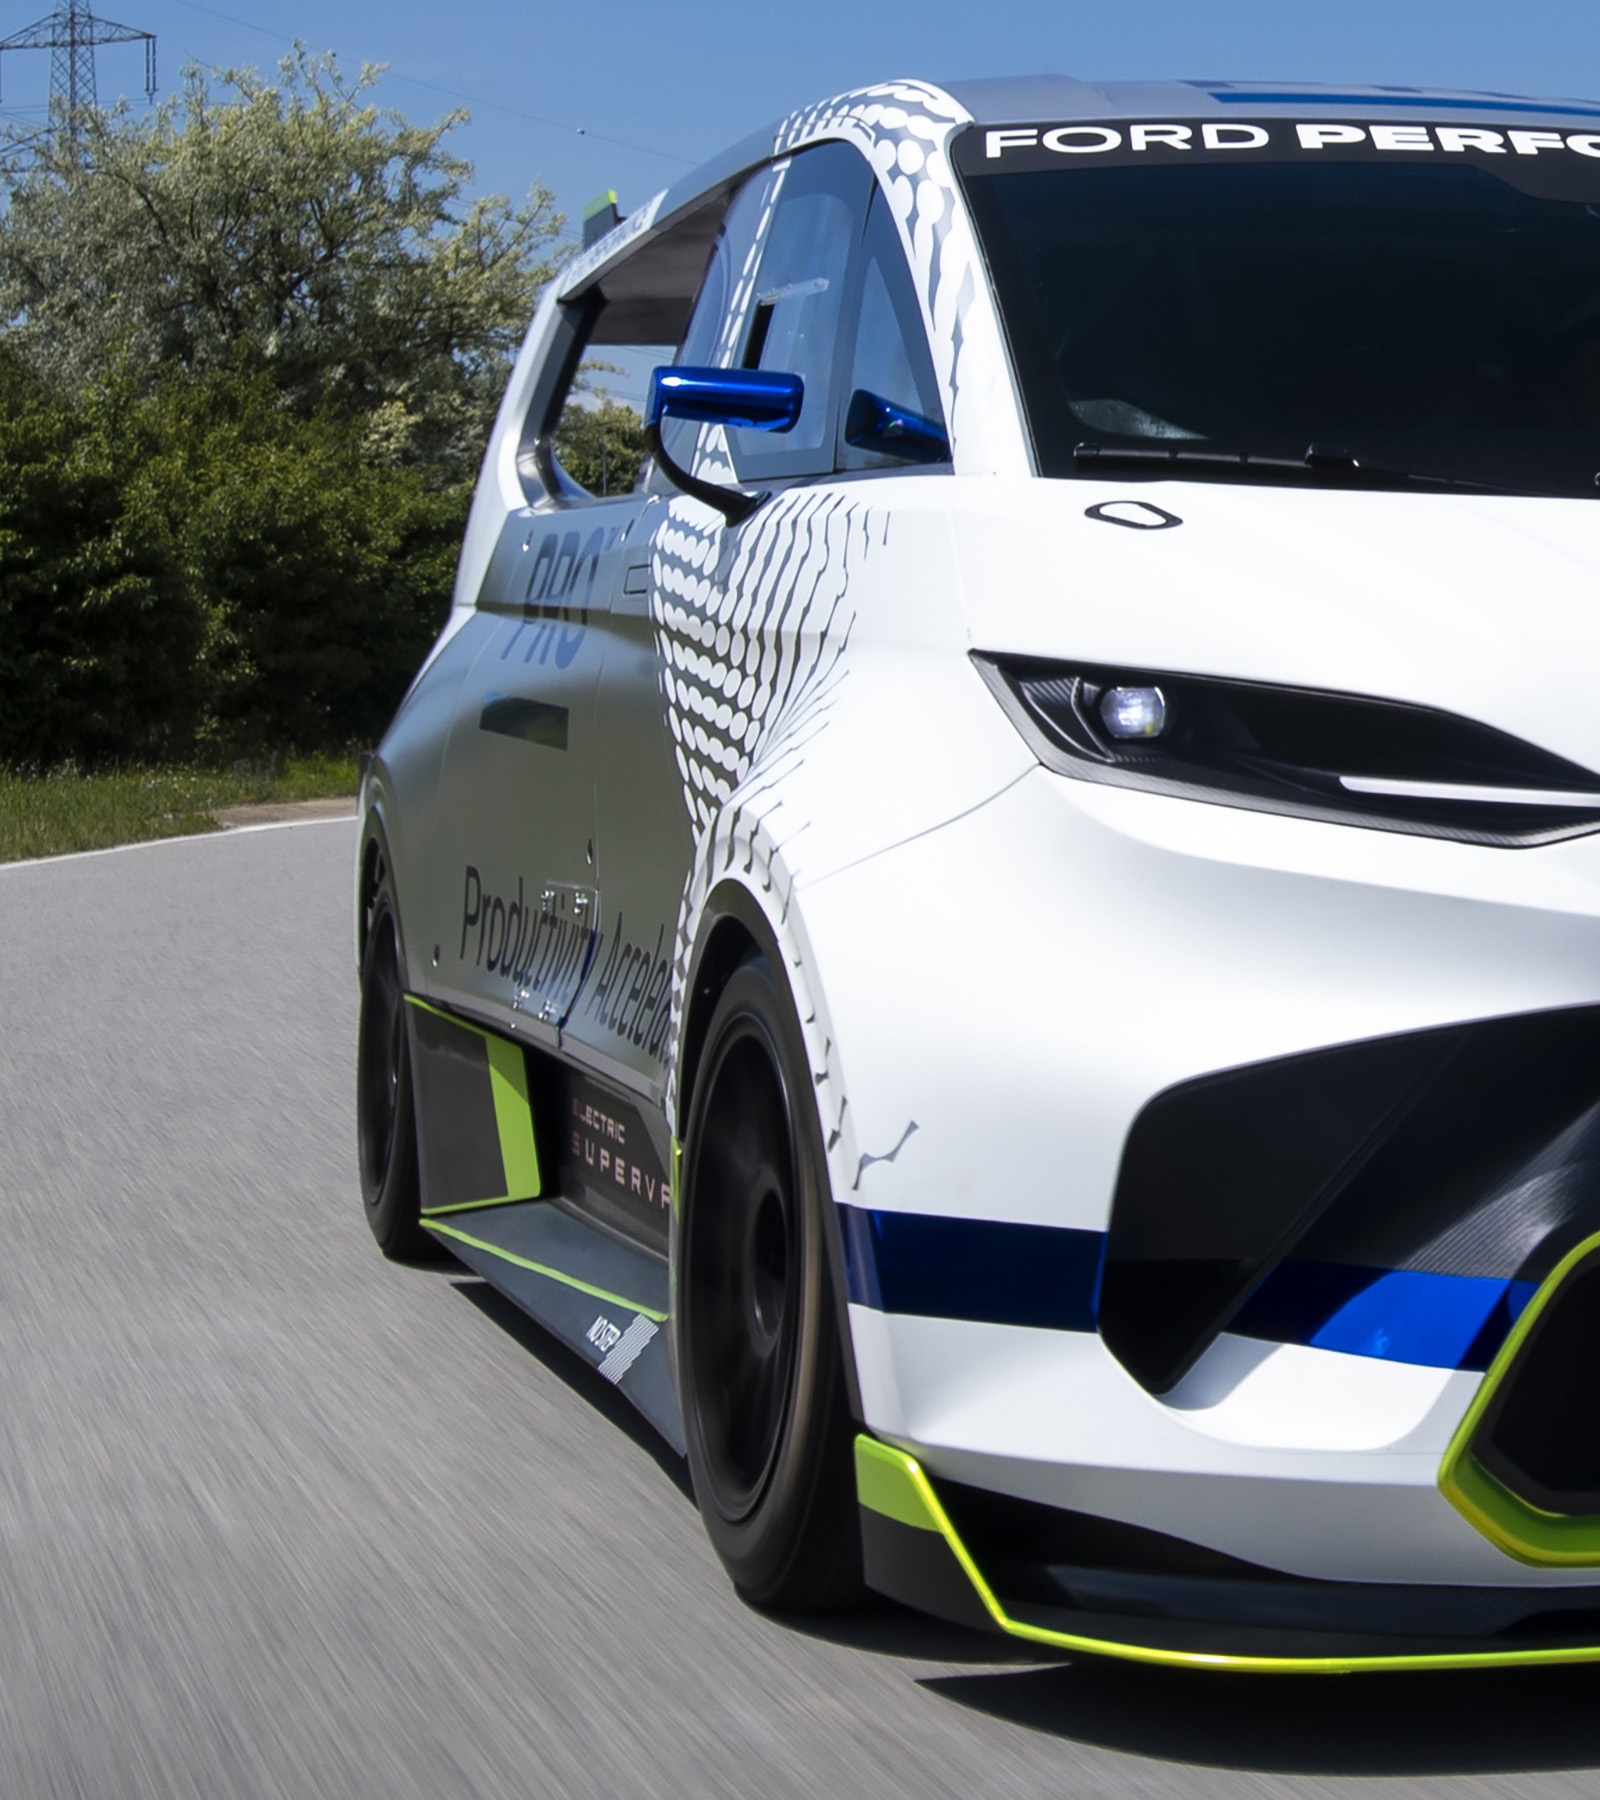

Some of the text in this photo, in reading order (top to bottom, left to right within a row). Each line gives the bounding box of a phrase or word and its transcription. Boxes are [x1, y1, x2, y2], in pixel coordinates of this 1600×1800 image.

[985, 123, 1269, 158] FORD
[500, 526, 605, 671] PRO
[572, 1097, 626, 1146] ELECTRIC
[585, 1314, 621, 1354] NO STEP
